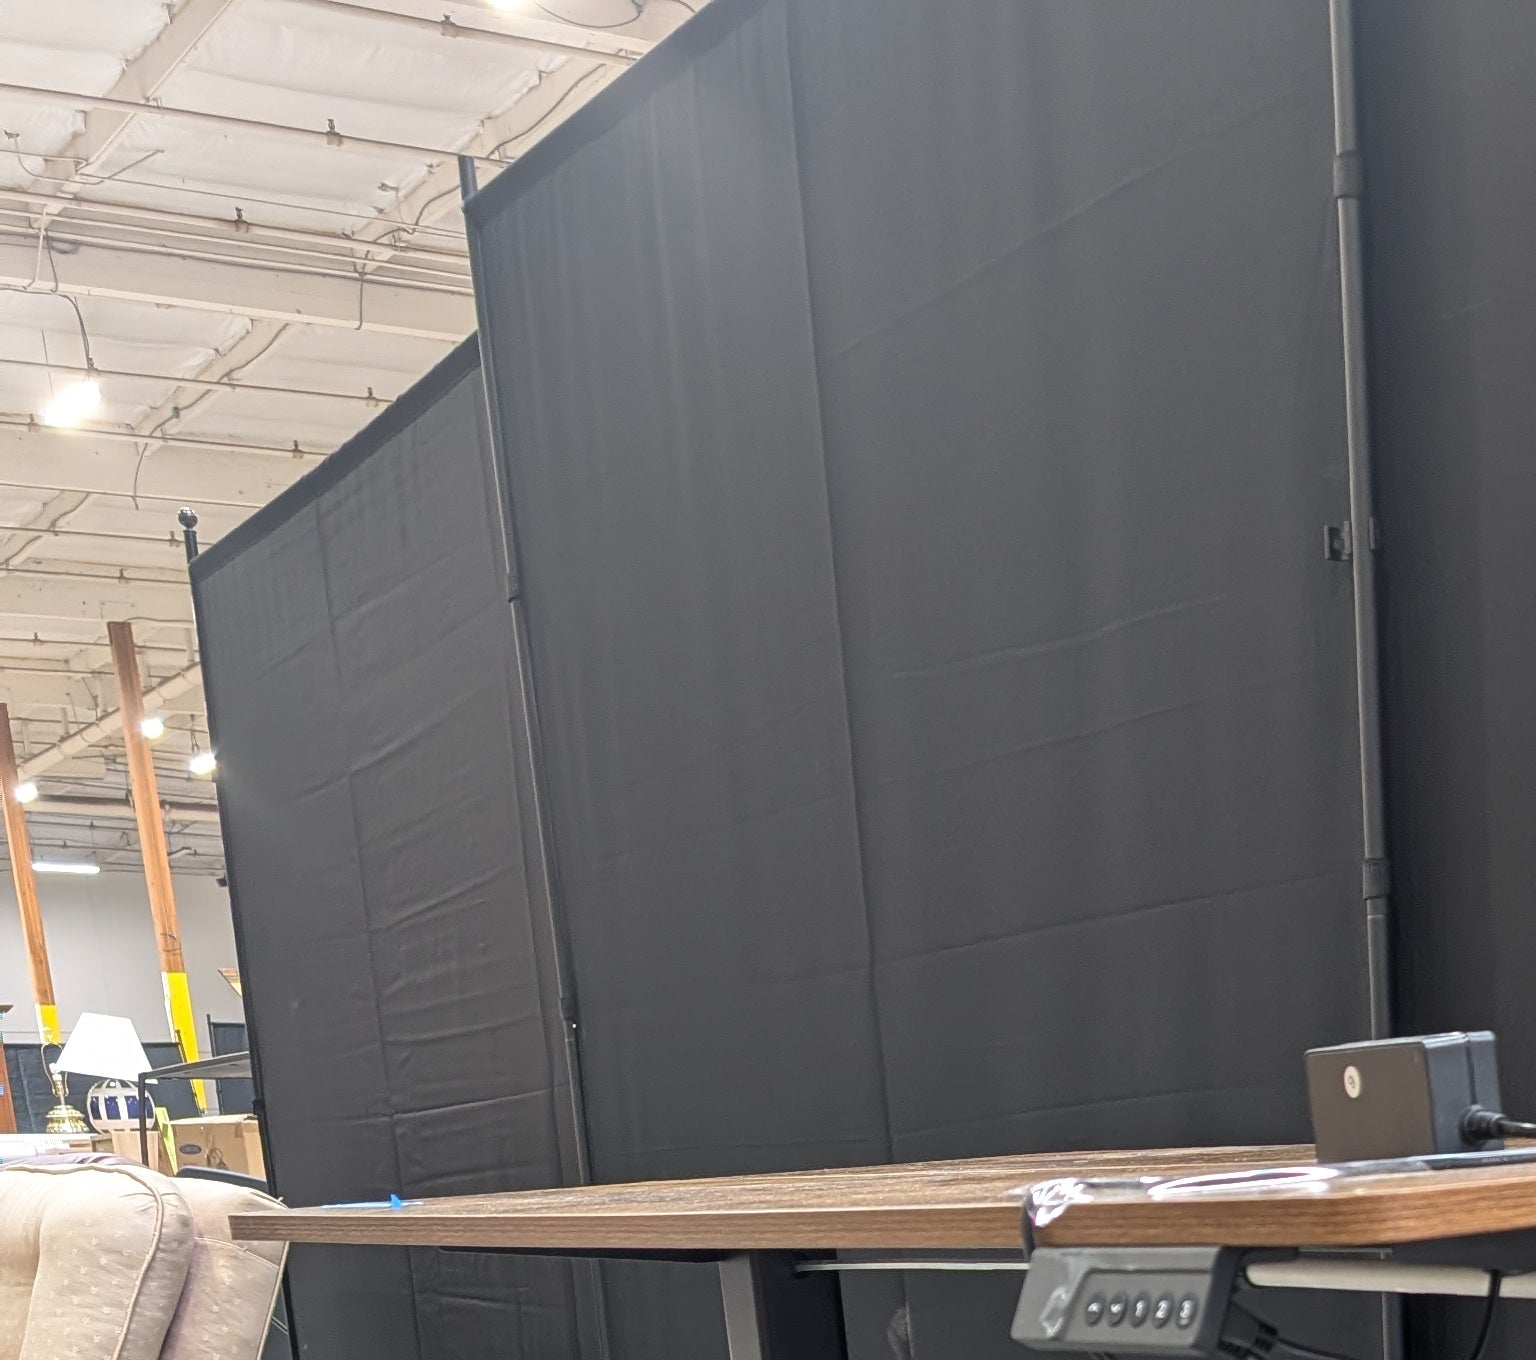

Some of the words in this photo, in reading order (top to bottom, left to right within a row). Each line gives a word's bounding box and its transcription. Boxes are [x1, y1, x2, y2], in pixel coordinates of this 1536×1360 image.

[1135, 1300, 1145, 1318] 1
[1155, 1300, 1169, 1319] 2
[1180, 1300, 1193, 1319] 3
